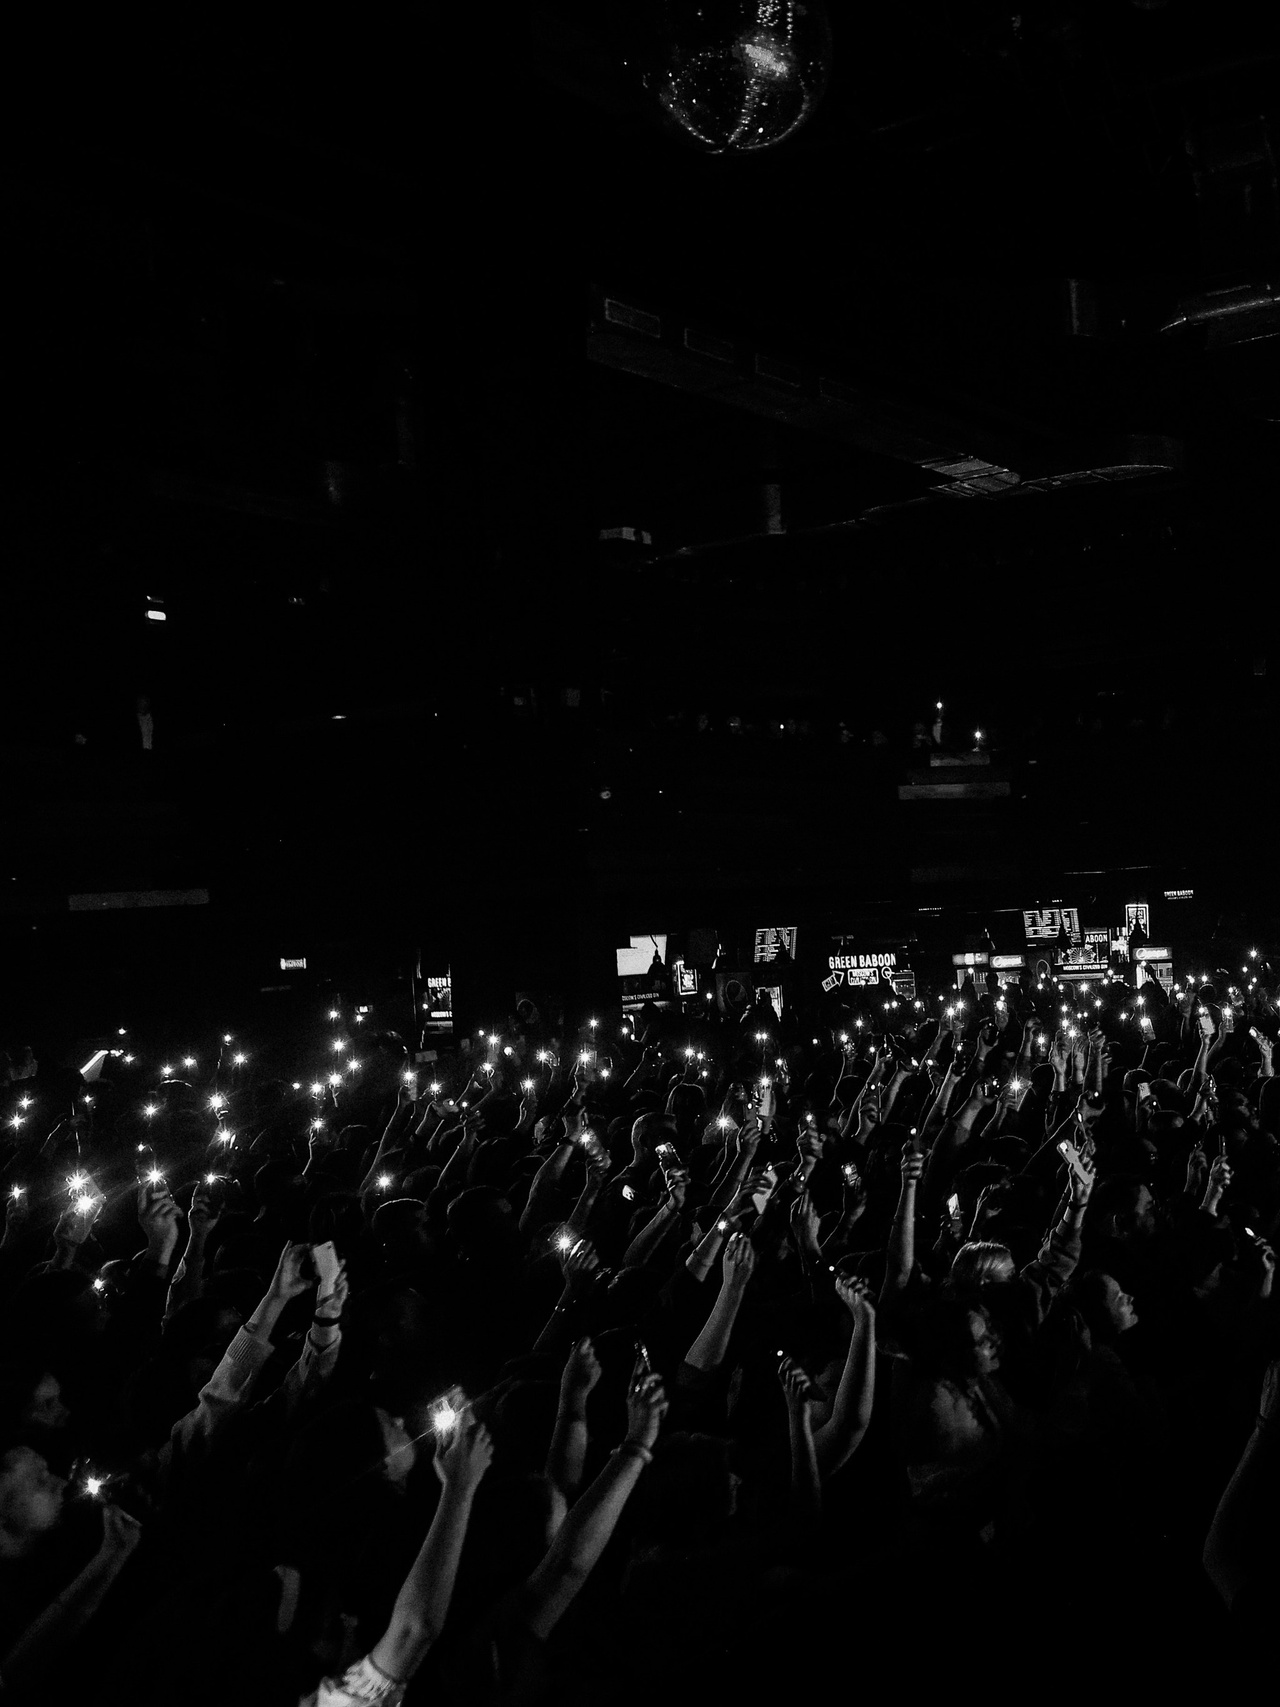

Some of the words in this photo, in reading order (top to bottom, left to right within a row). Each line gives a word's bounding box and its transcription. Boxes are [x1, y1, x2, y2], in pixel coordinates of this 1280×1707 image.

[1085, 934, 1108, 943] ABOON
[828, 955, 858, 969] GREEN
[859, 953, 896, 967] BABOON
[427, 977, 447, 988] GREEN
